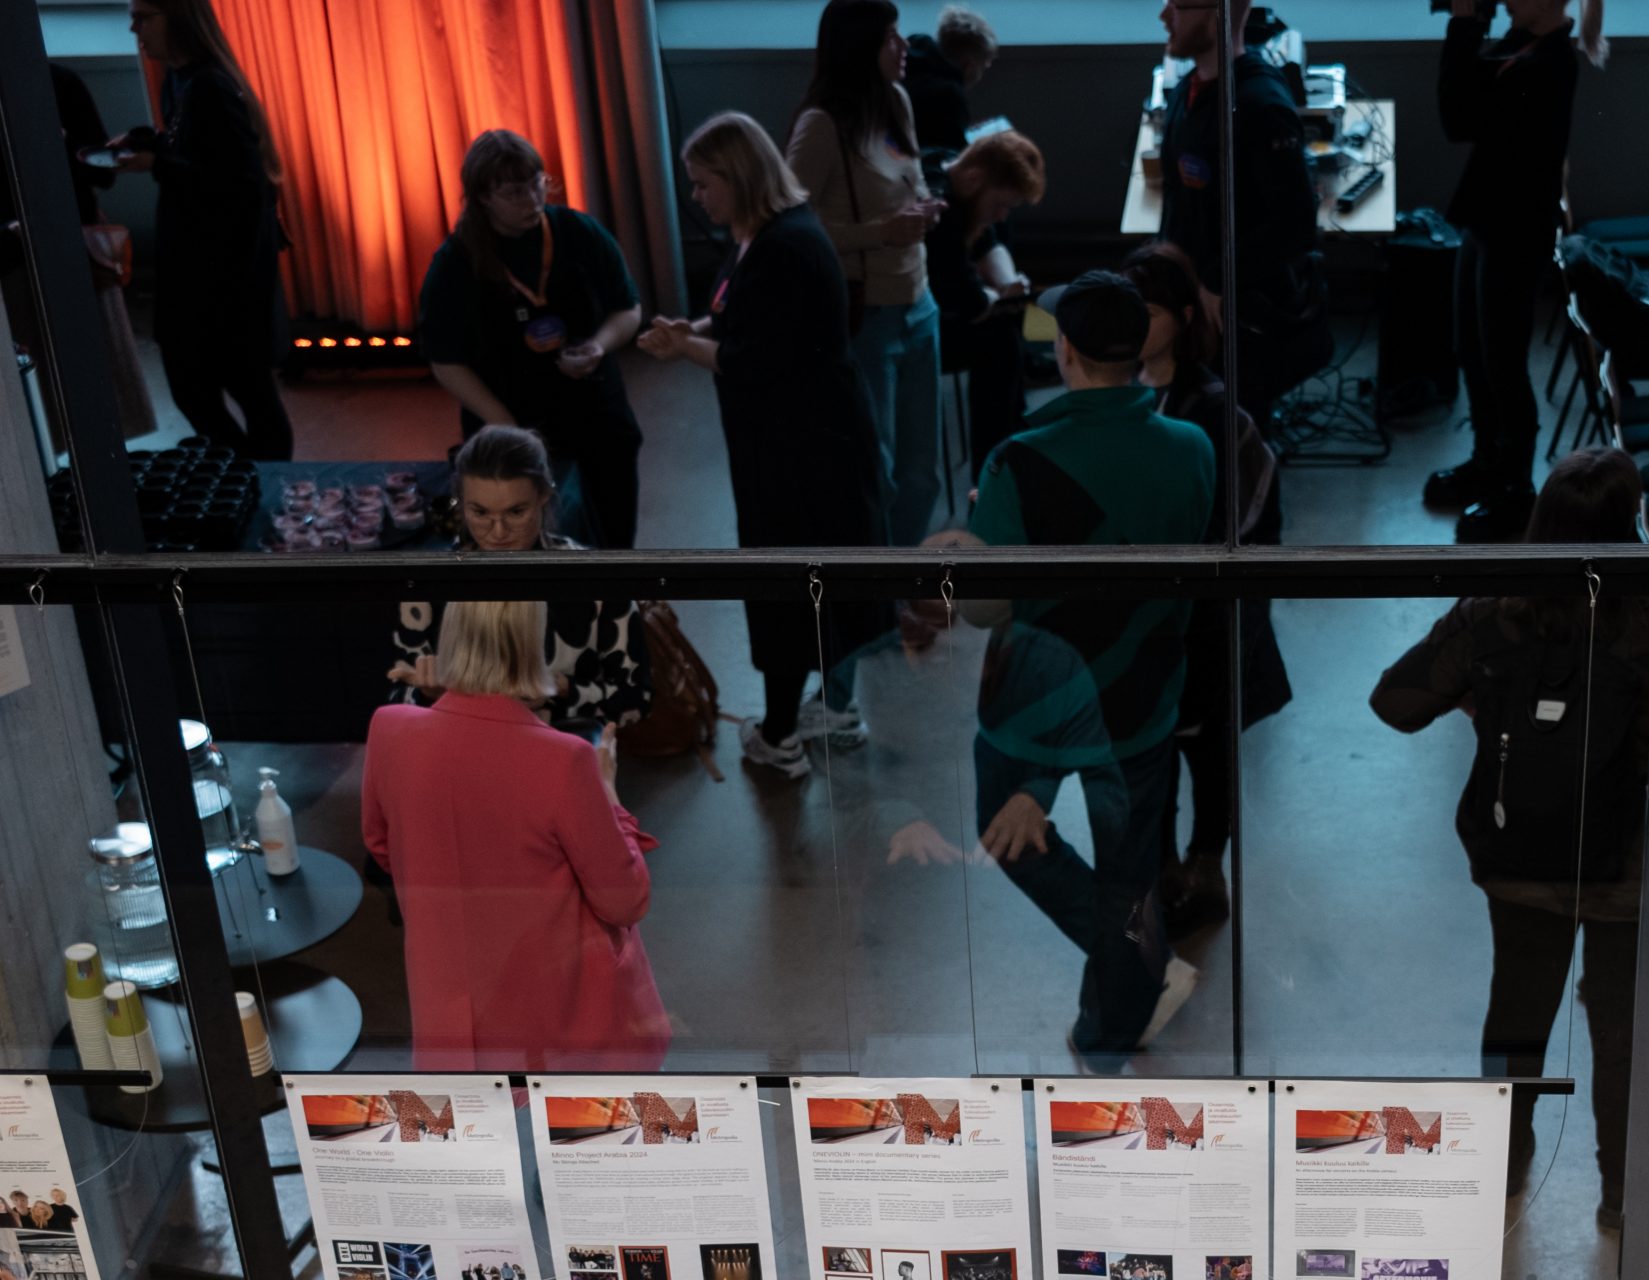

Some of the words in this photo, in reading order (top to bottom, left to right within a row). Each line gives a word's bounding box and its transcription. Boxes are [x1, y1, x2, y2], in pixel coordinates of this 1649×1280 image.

[576, 1152, 602, 1160] Project
[874, 1152, 920, 1160] documentary
[1052, 1154, 1096, 1162] Bändiständi
[350, 1244, 374, 1252] WORLD
[630, 1253, 662, 1263] TIME
